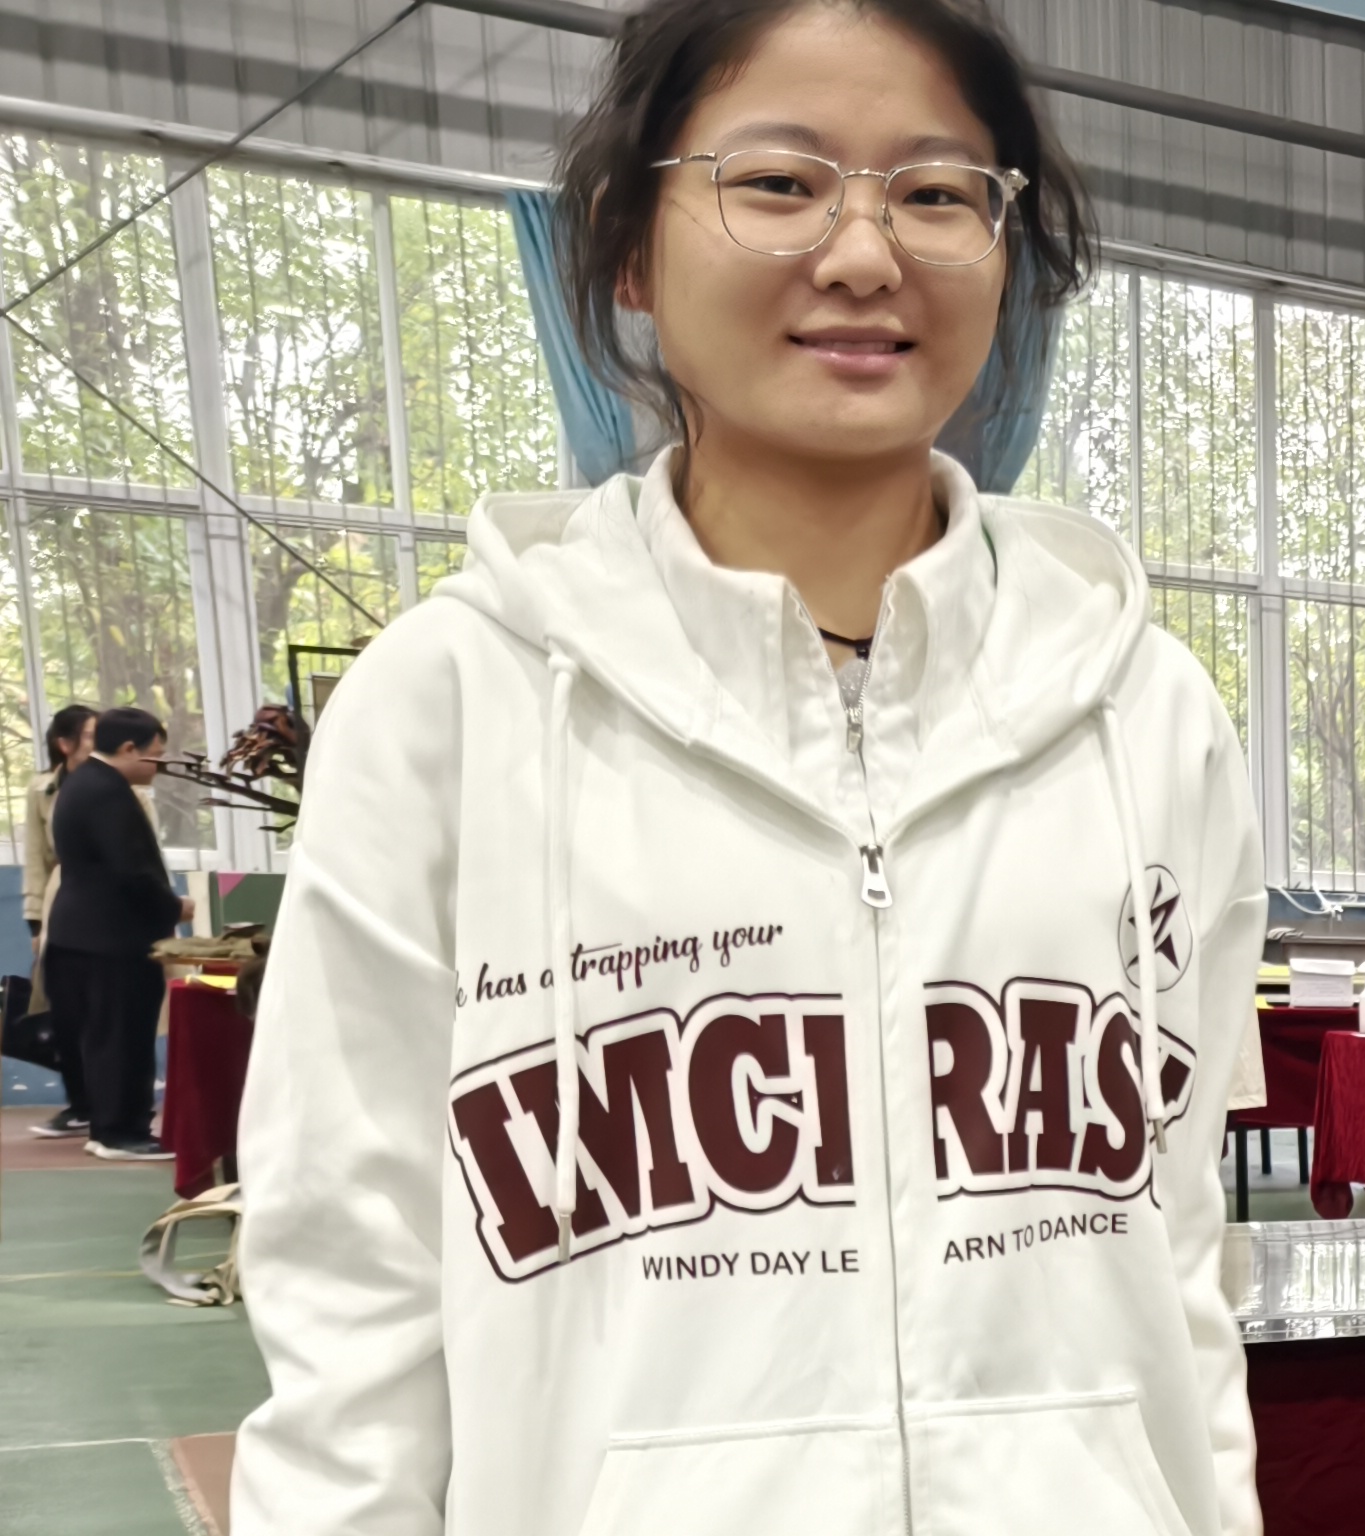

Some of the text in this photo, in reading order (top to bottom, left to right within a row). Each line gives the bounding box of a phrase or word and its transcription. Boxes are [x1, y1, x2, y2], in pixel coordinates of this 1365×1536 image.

[476, 962, 528, 1002] has
[570, 934, 702, 992] trapping
[712, 923, 784, 968] your
[642, 1251, 740, 1281] WINDY
[750, 1250, 811, 1277] DAY
[1011, 1224, 1036, 1252] TO
[1038, 1212, 1129, 1243] DANCE
